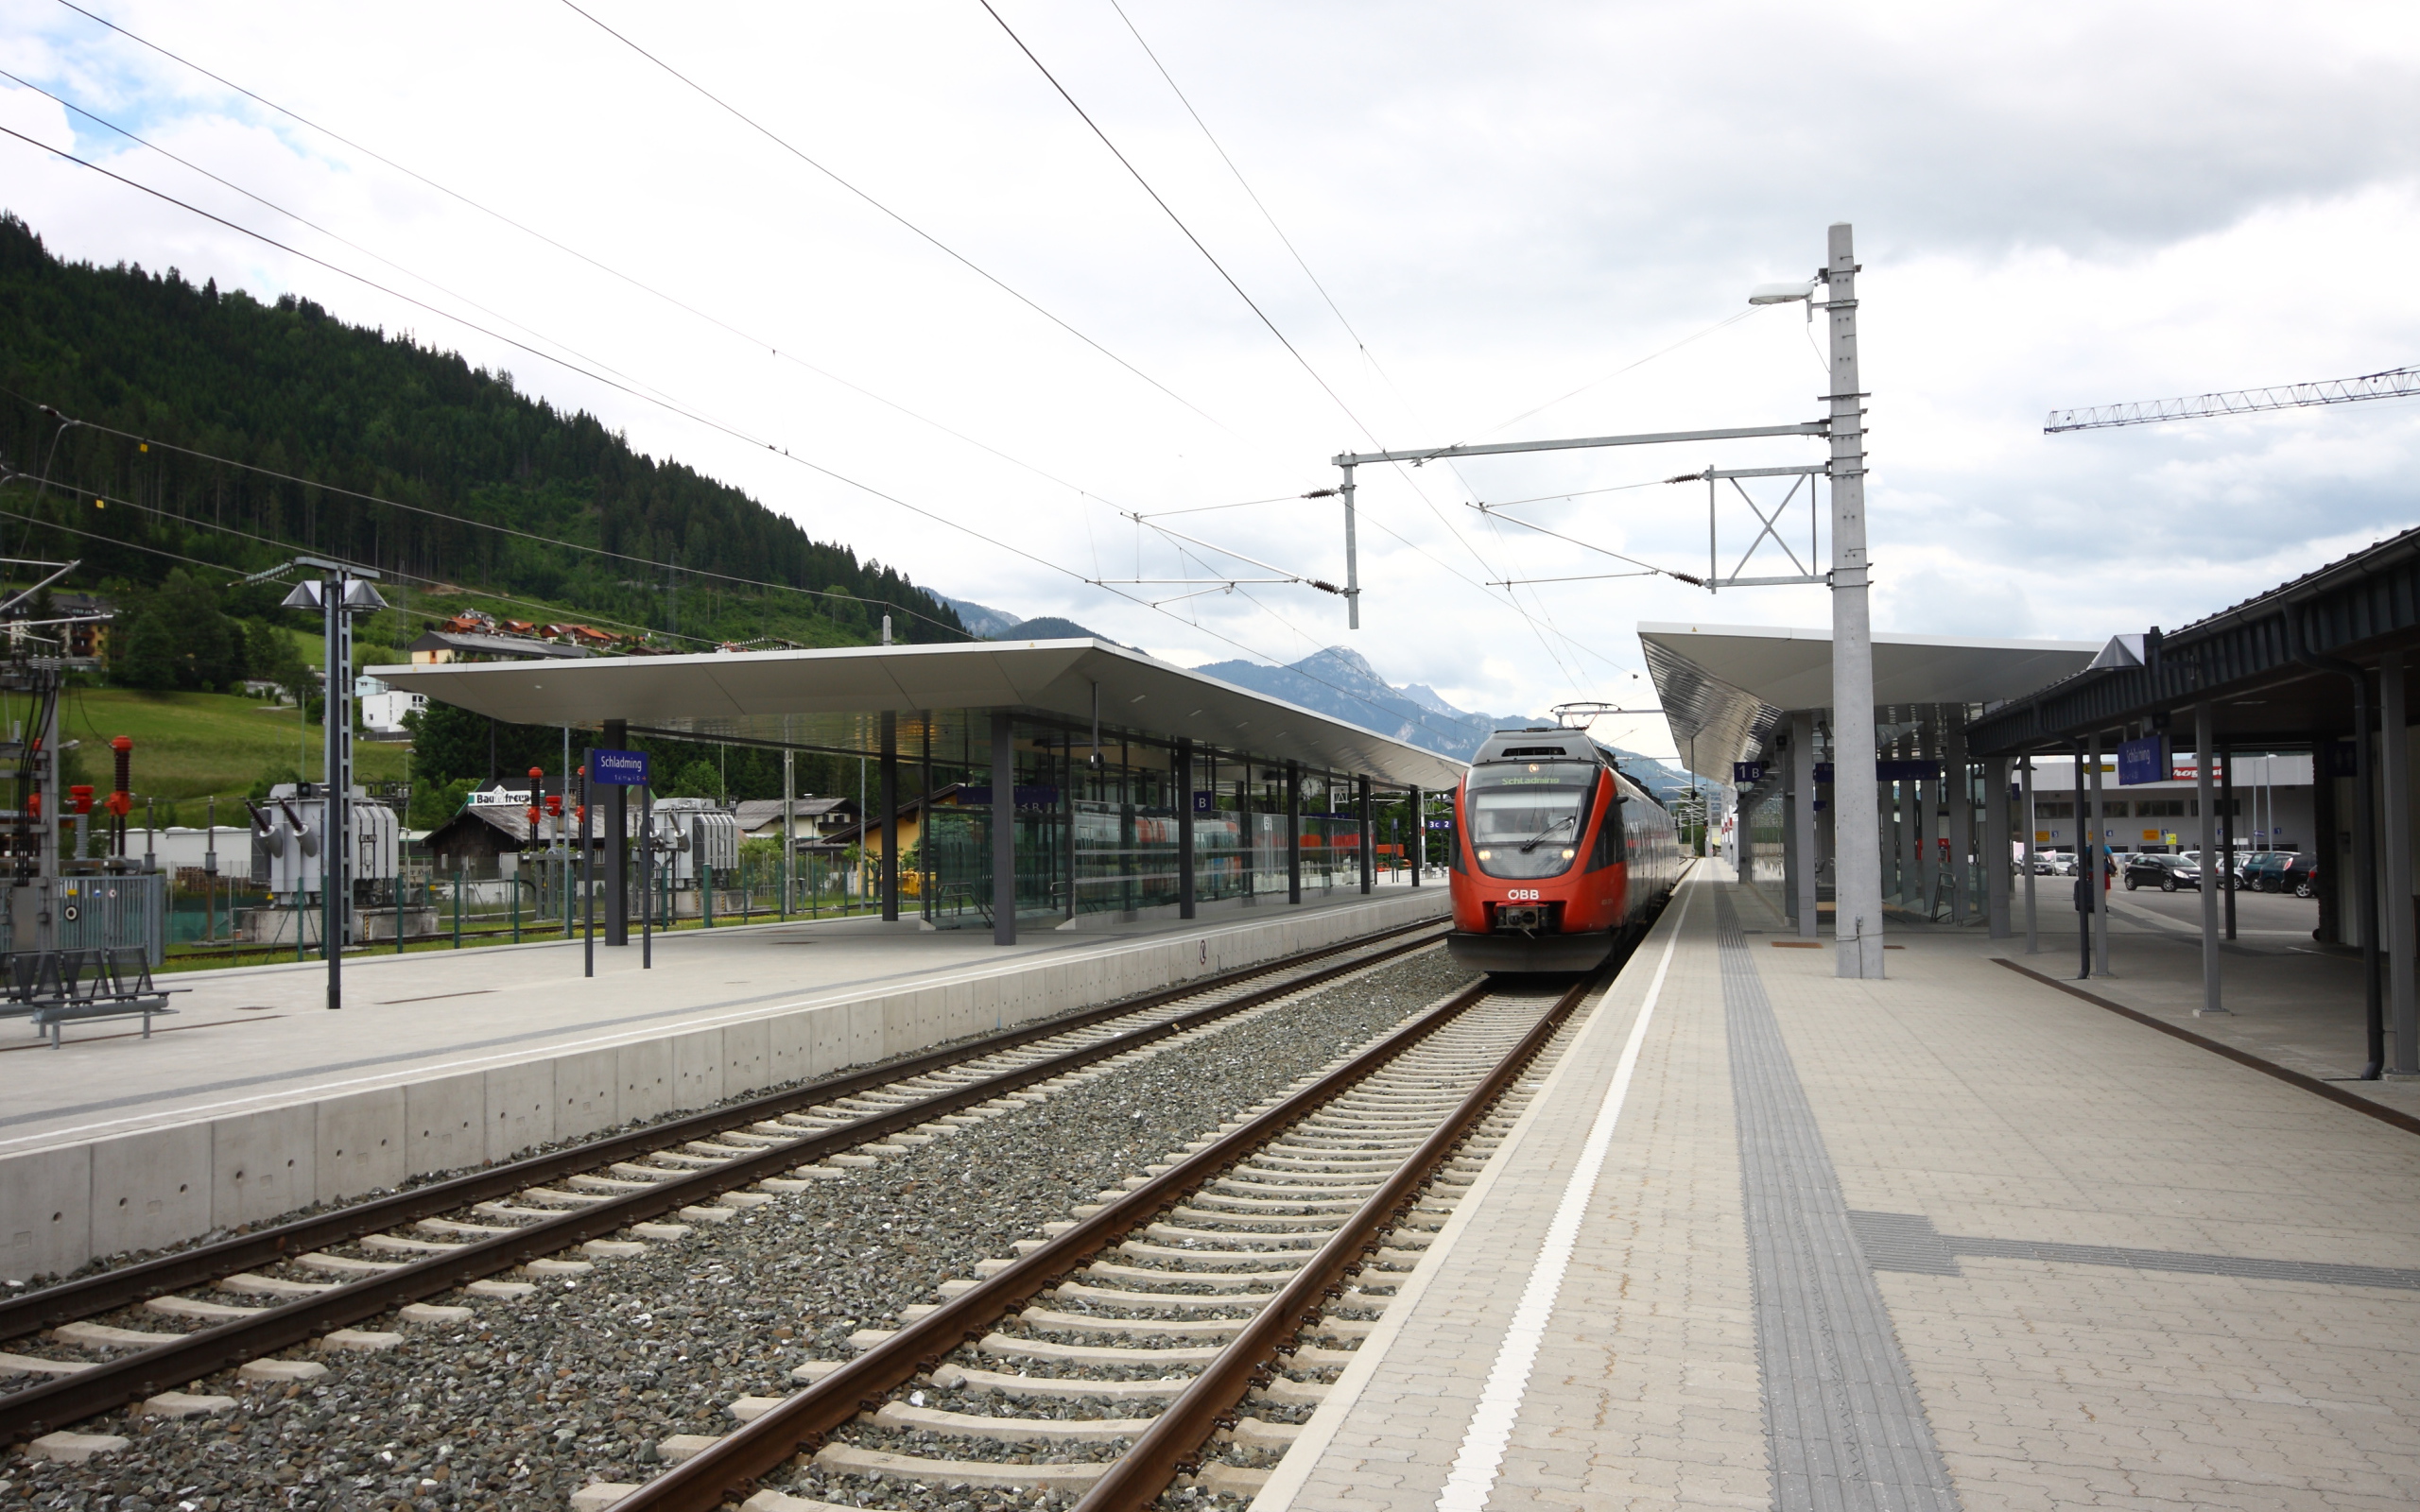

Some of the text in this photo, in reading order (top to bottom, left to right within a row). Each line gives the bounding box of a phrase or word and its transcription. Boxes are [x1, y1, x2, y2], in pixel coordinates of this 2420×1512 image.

[601, 756, 642, 772] Schladming
[1739, 765, 1759, 779] 1 B
[477, 795, 494, 803] Bau
[1199, 798, 1206, 808] B
[1508, 889, 1539, 900] ÖBB
